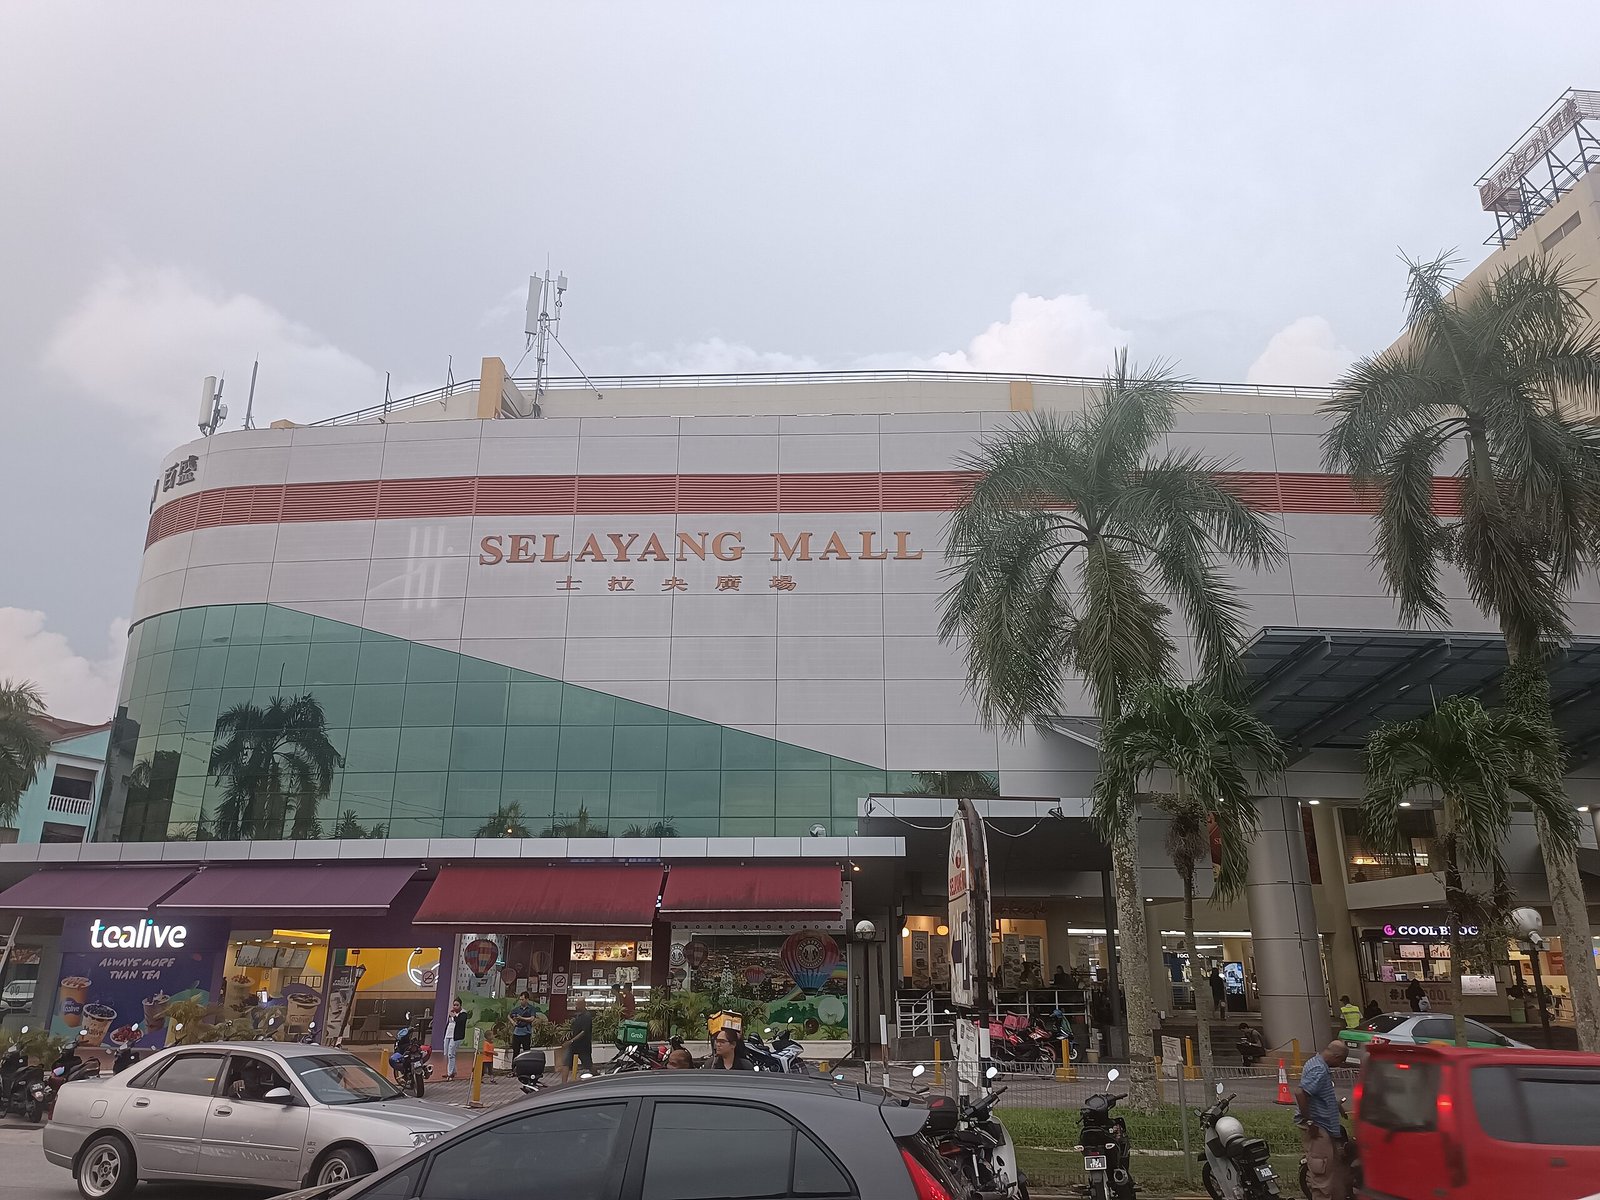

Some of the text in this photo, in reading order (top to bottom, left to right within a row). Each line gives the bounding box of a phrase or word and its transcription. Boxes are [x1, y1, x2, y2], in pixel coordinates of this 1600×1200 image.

[1481, 129, 1549, 200] PARKSON
[162, 455, 199, 492] 百盛
[479, 531, 923, 566] SELAYANG MALL
[90, 918, 188, 949] tealive
[1397, 925, 1479, 936] COOLBOG
[99, 957, 176, 968] ALWAYS MORE
[110, 970, 161, 980] THAN TEA
[630, 1031, 644, 1039] Grab
